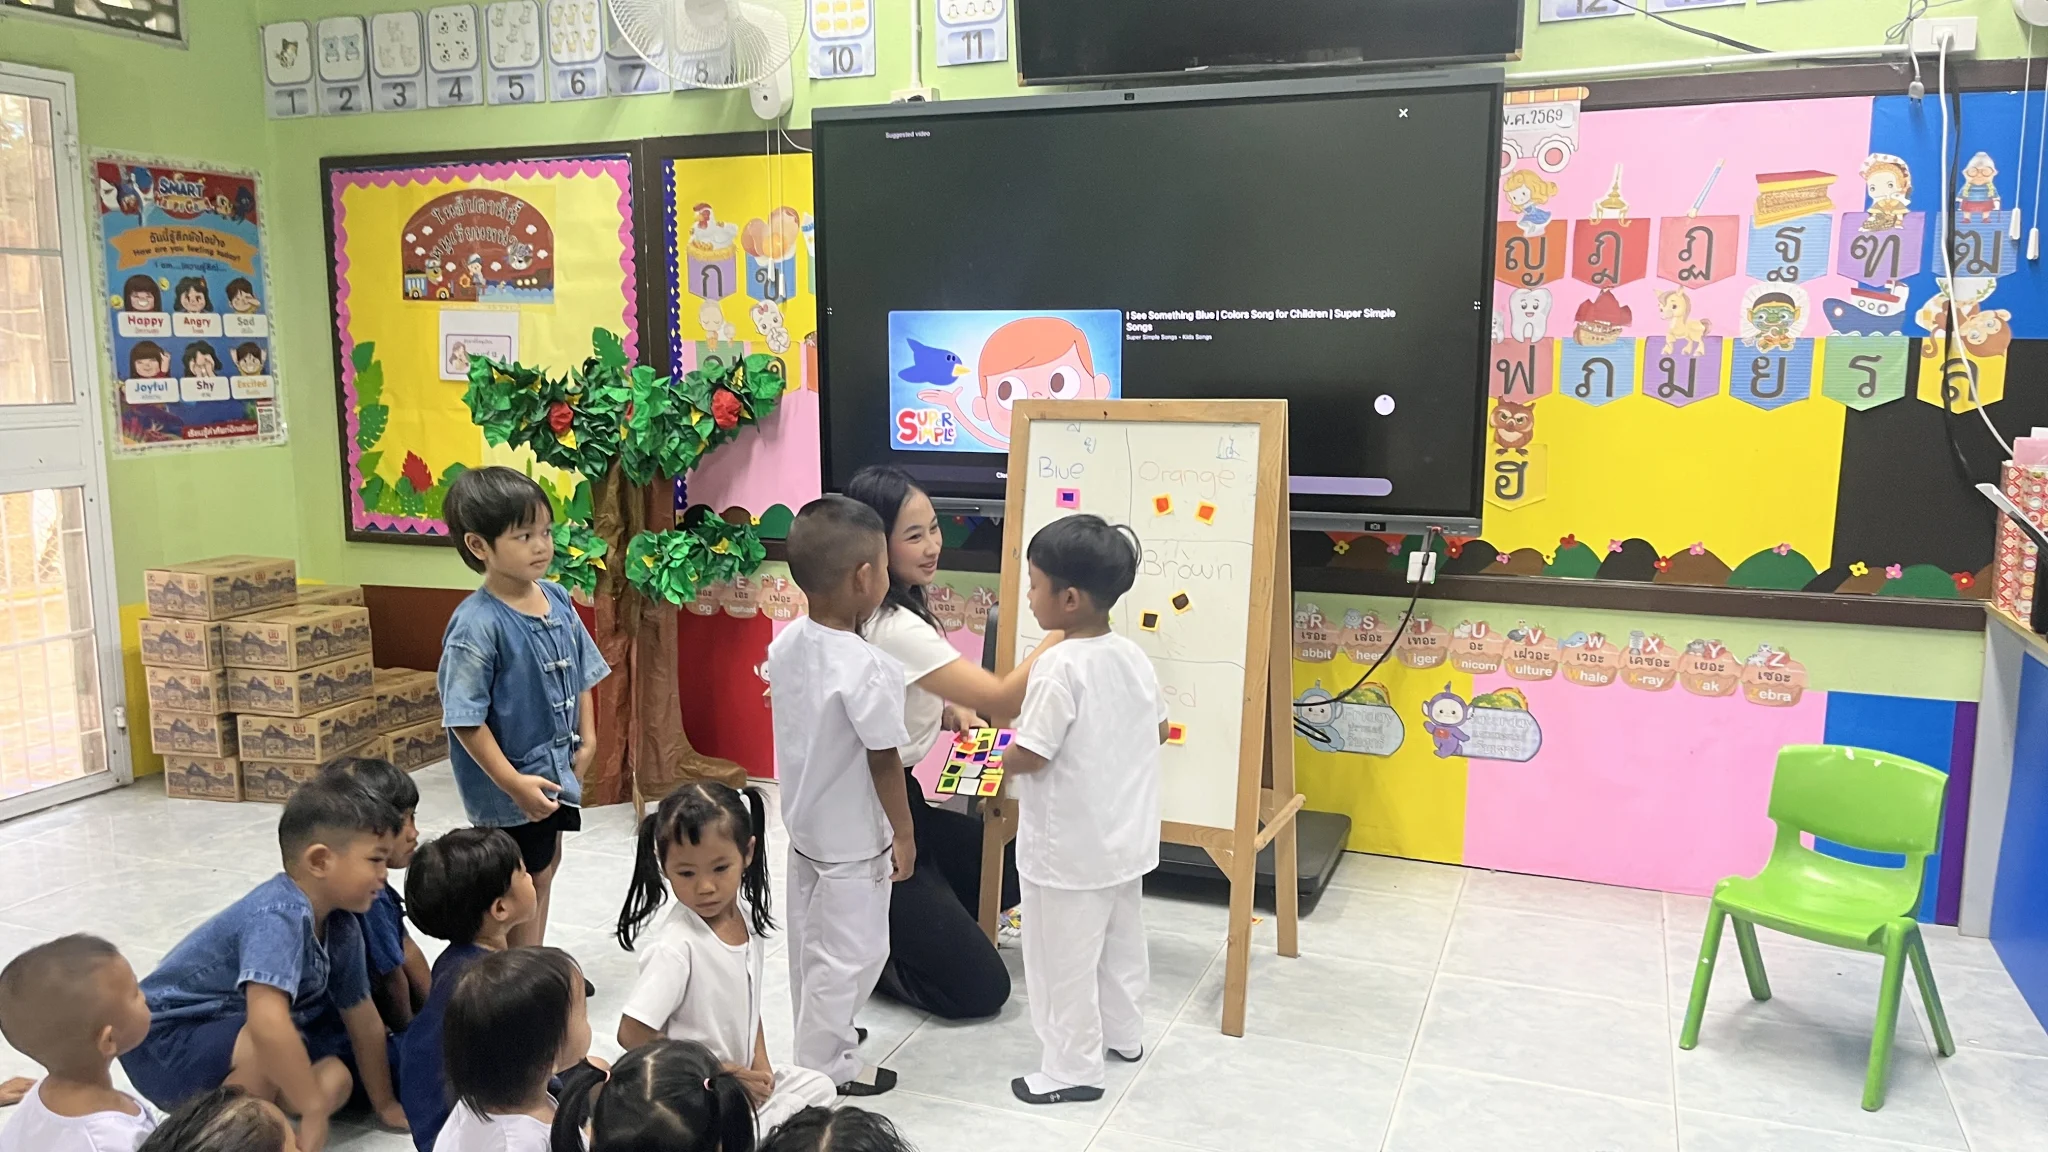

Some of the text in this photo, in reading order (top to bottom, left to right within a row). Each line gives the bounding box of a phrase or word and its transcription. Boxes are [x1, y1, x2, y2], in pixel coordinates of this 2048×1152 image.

[961, 30, 984, 60] 11
[828, 46, 855, 74] 10
[571, 70, 586, 96] 6
[631, 63, 646, 90] 7
[392, 81, 407, 108] 3
[448, 77, 464, 102] 4
[508, 75, 525, 101] 5
[287, 94, 297, 114] 1
[338, 87, 353, 111] 2
[885, 131, 915, 140] Suggested
[159, 176, 205, 199] SMART
[132, 248, 152, 257] How
[154, 246, 168, 254] are
[169, 246, 185, 254] you
[187, 244, 215, 257] feeling
[1766, 226, 1807, 283] ฐ
[1850, 233, 1900, 279] ฑ
[1504, 235, 1546, 287] ญ
[701, 264, 723, 298] ก
[128, 315, 164, 329] Happy
[183, 316, 212, 329] Angry
[237, 316, 256, 327] Sad
[1130, 311, 1147, 320] See
[1148, 310, 1195, 321] Something
[1195, 310, 1216, 320] Blue
[1220, 310, 1250, 320] Colors
[1250, 309, 1275, 321] Song
[1275, 309, 1289, 319] for
[1289, 308, 1329, 319] Children
[1333, 309, 1363, 320] Super
[1363, 308, 1397, 320] Simple
[1126, 322, 1153, 333] Songs
[1496, 344, 1536, 395] ฟ
[1574, 356, 1615, 399] ภ
[1657, 356, 1697, 399] ม
[1750, 355, 1787, 399] ย
[1849, 355, 1883, 399] ร
[134, 381, 169, 395] Joyful
[196, 380, 215, 392] Shy
[237, 380, 268, 389] Excited
[1038, 456, 1085, 480] Blue
[1138, 460, 1236, 500] Orange
[1495, 461, 1529, 500] ฮ
[1142, 549, 1233, 581] Brown
[735, 576, 747, 589] E
[776, 578, 787, 591] F
[941, 588, 950, 601] J
[1309, 613, 1323, 628] R
[1362, 615, 1375, 630] S
[1416, 618, 1430, 633] T
[1471, 623, 1486, 639] U
[1528, 629, 1543, 645] V
[1587, 635, 1605, 649] W
[1646, 637, 1660, 653] X
[1296, 646, 1332, 660] abbit
[1708, 643, 1722, 659] Y
[1769, 651, 1787, 668] Z
[1569, 668, 1609, 684] Whale
[1628, 671, 1666, 688] X-ray
[1695, 679, 1720, 692] Yak
[1163, 681, 1197, 708] ed
[1749, 687, 1793, 702] Zebra
[1342, 706, 1395, 728] Friday
